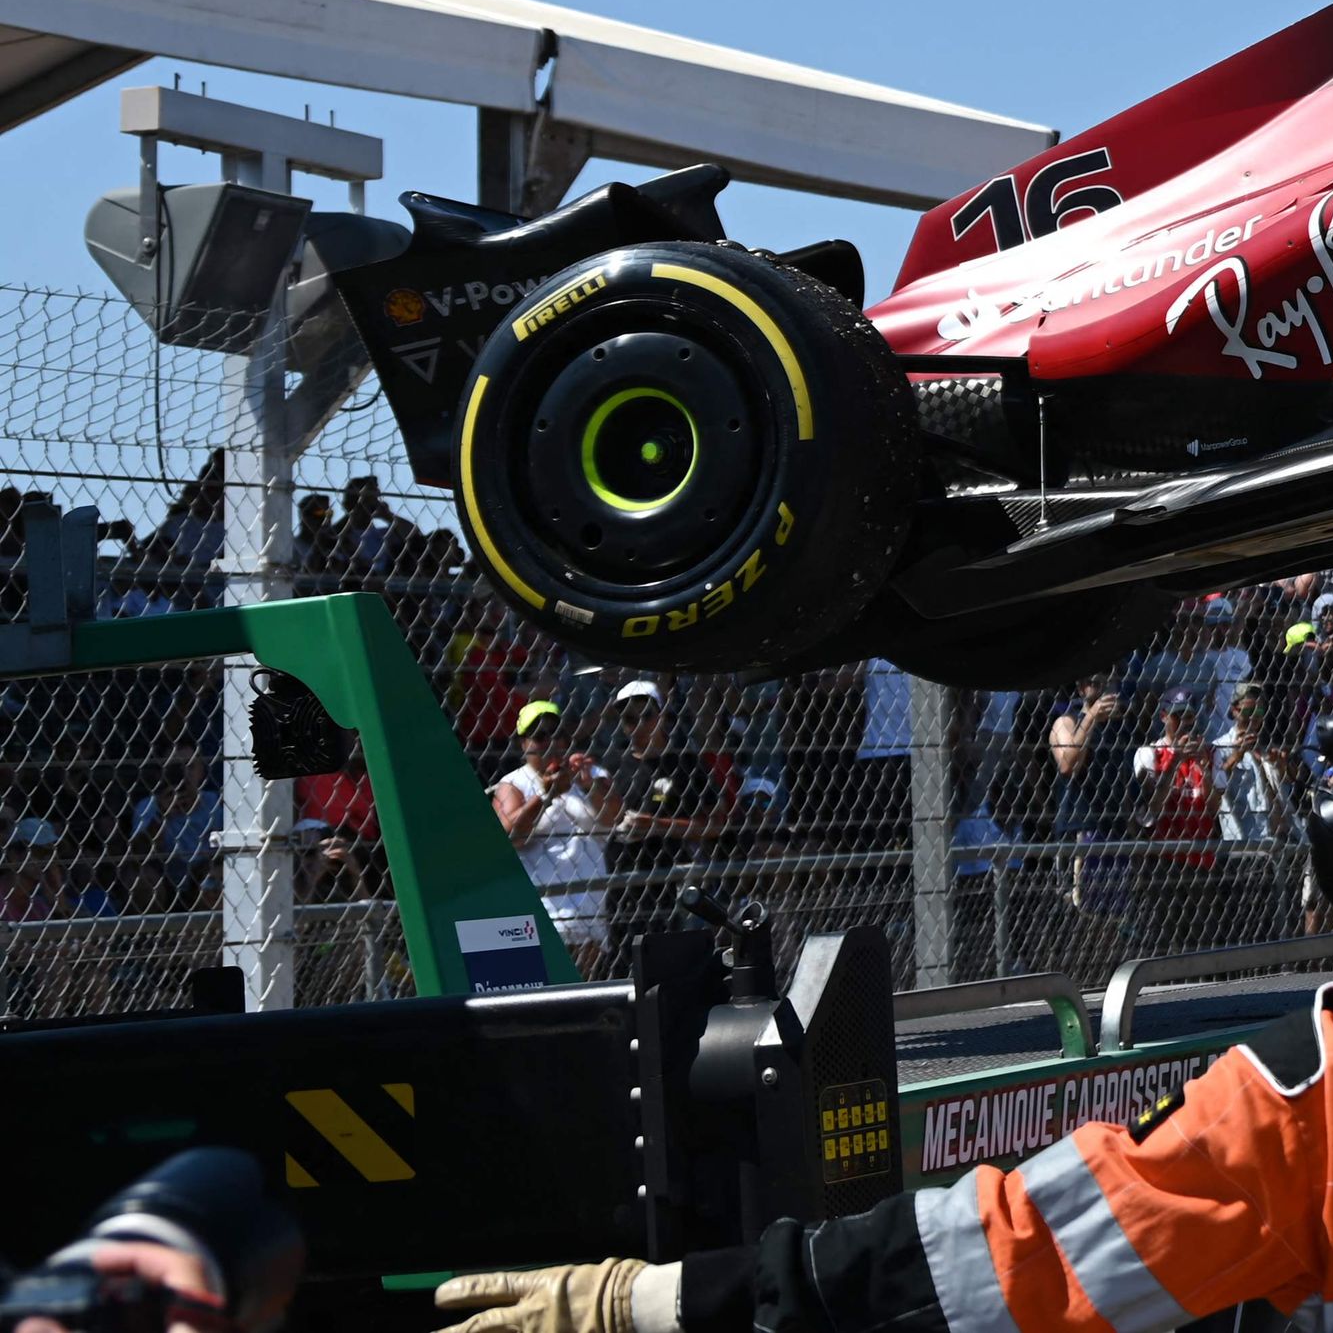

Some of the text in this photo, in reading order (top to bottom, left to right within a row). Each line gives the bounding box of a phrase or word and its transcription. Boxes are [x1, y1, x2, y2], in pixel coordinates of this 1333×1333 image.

[948, 146, 1126, 255] 16
[423, 275, 549, 317] V-Pow
[511, 267, 608, 343] PIRELLI
[621, 500, 795, 638] P ZERO
[922, 1079, 1056, 1172] MECANIQUE
